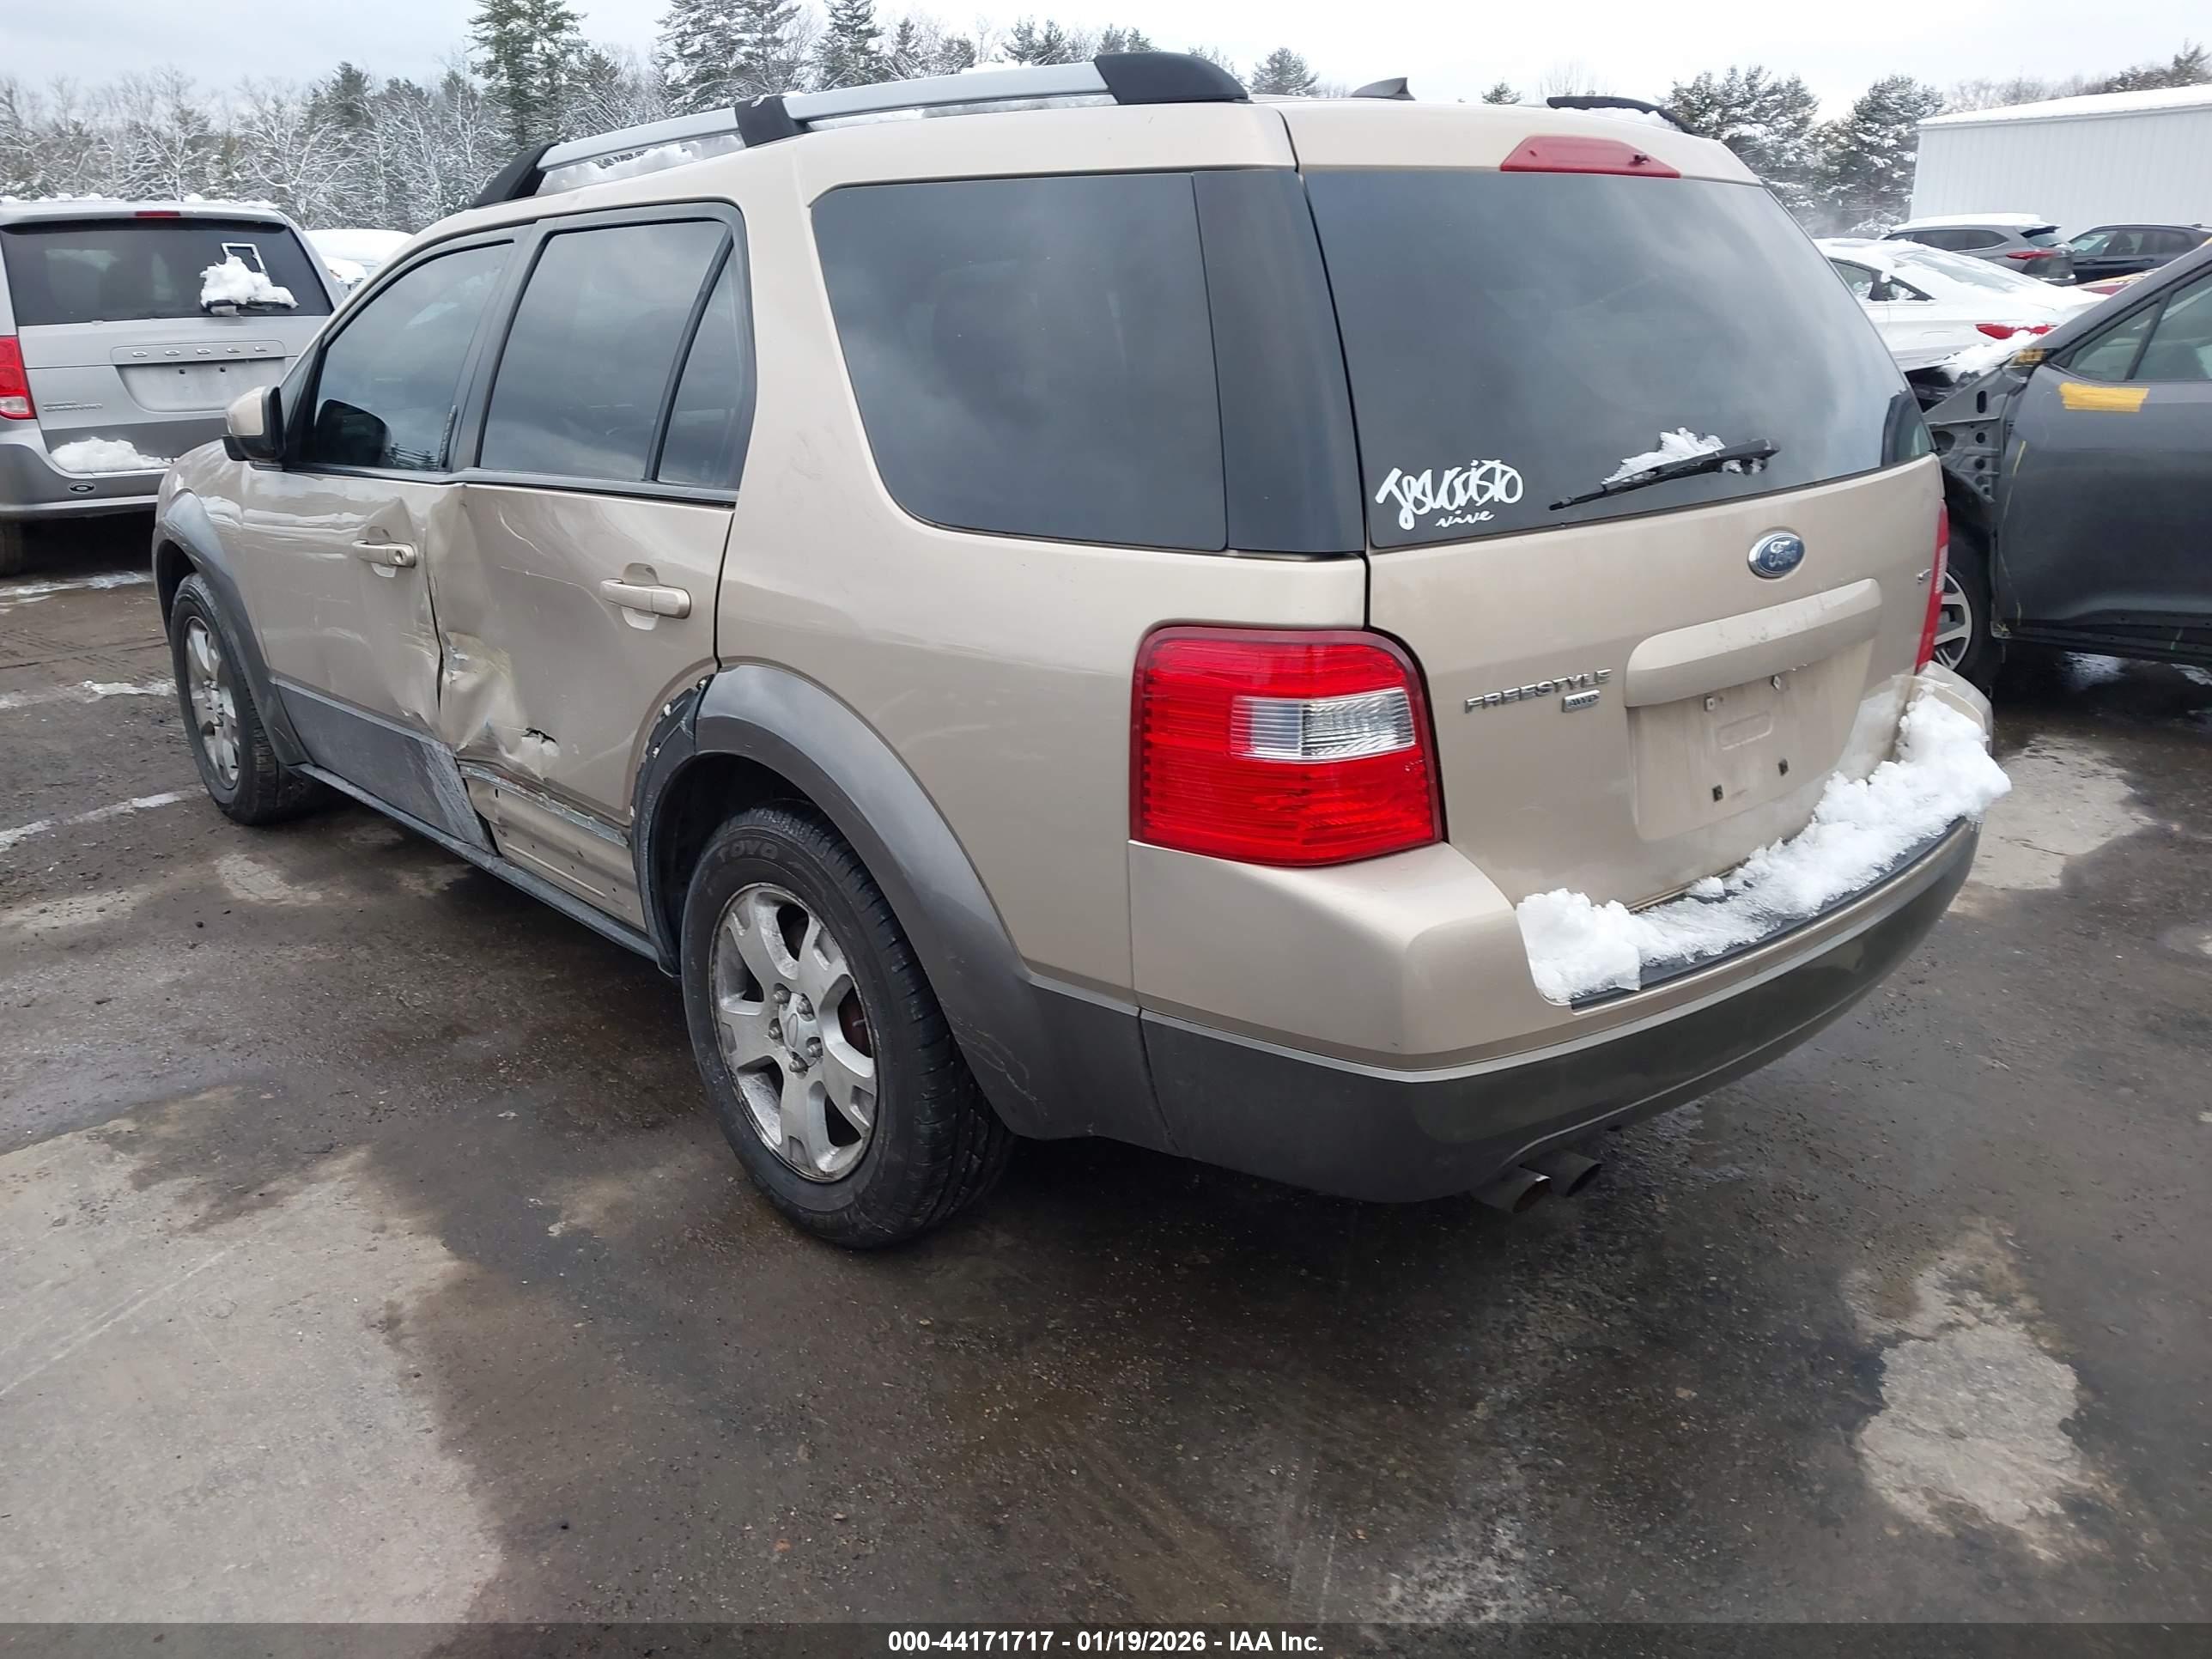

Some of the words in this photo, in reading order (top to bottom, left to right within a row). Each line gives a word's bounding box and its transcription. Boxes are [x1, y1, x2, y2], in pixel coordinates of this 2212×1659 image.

[132, 345, 268, 358] DODGE
[1436, 509, 1496, 528] vive
[1464, 668, 1613, 714] FREESTYLE
[1566, 693, 1599, 709] AWD
